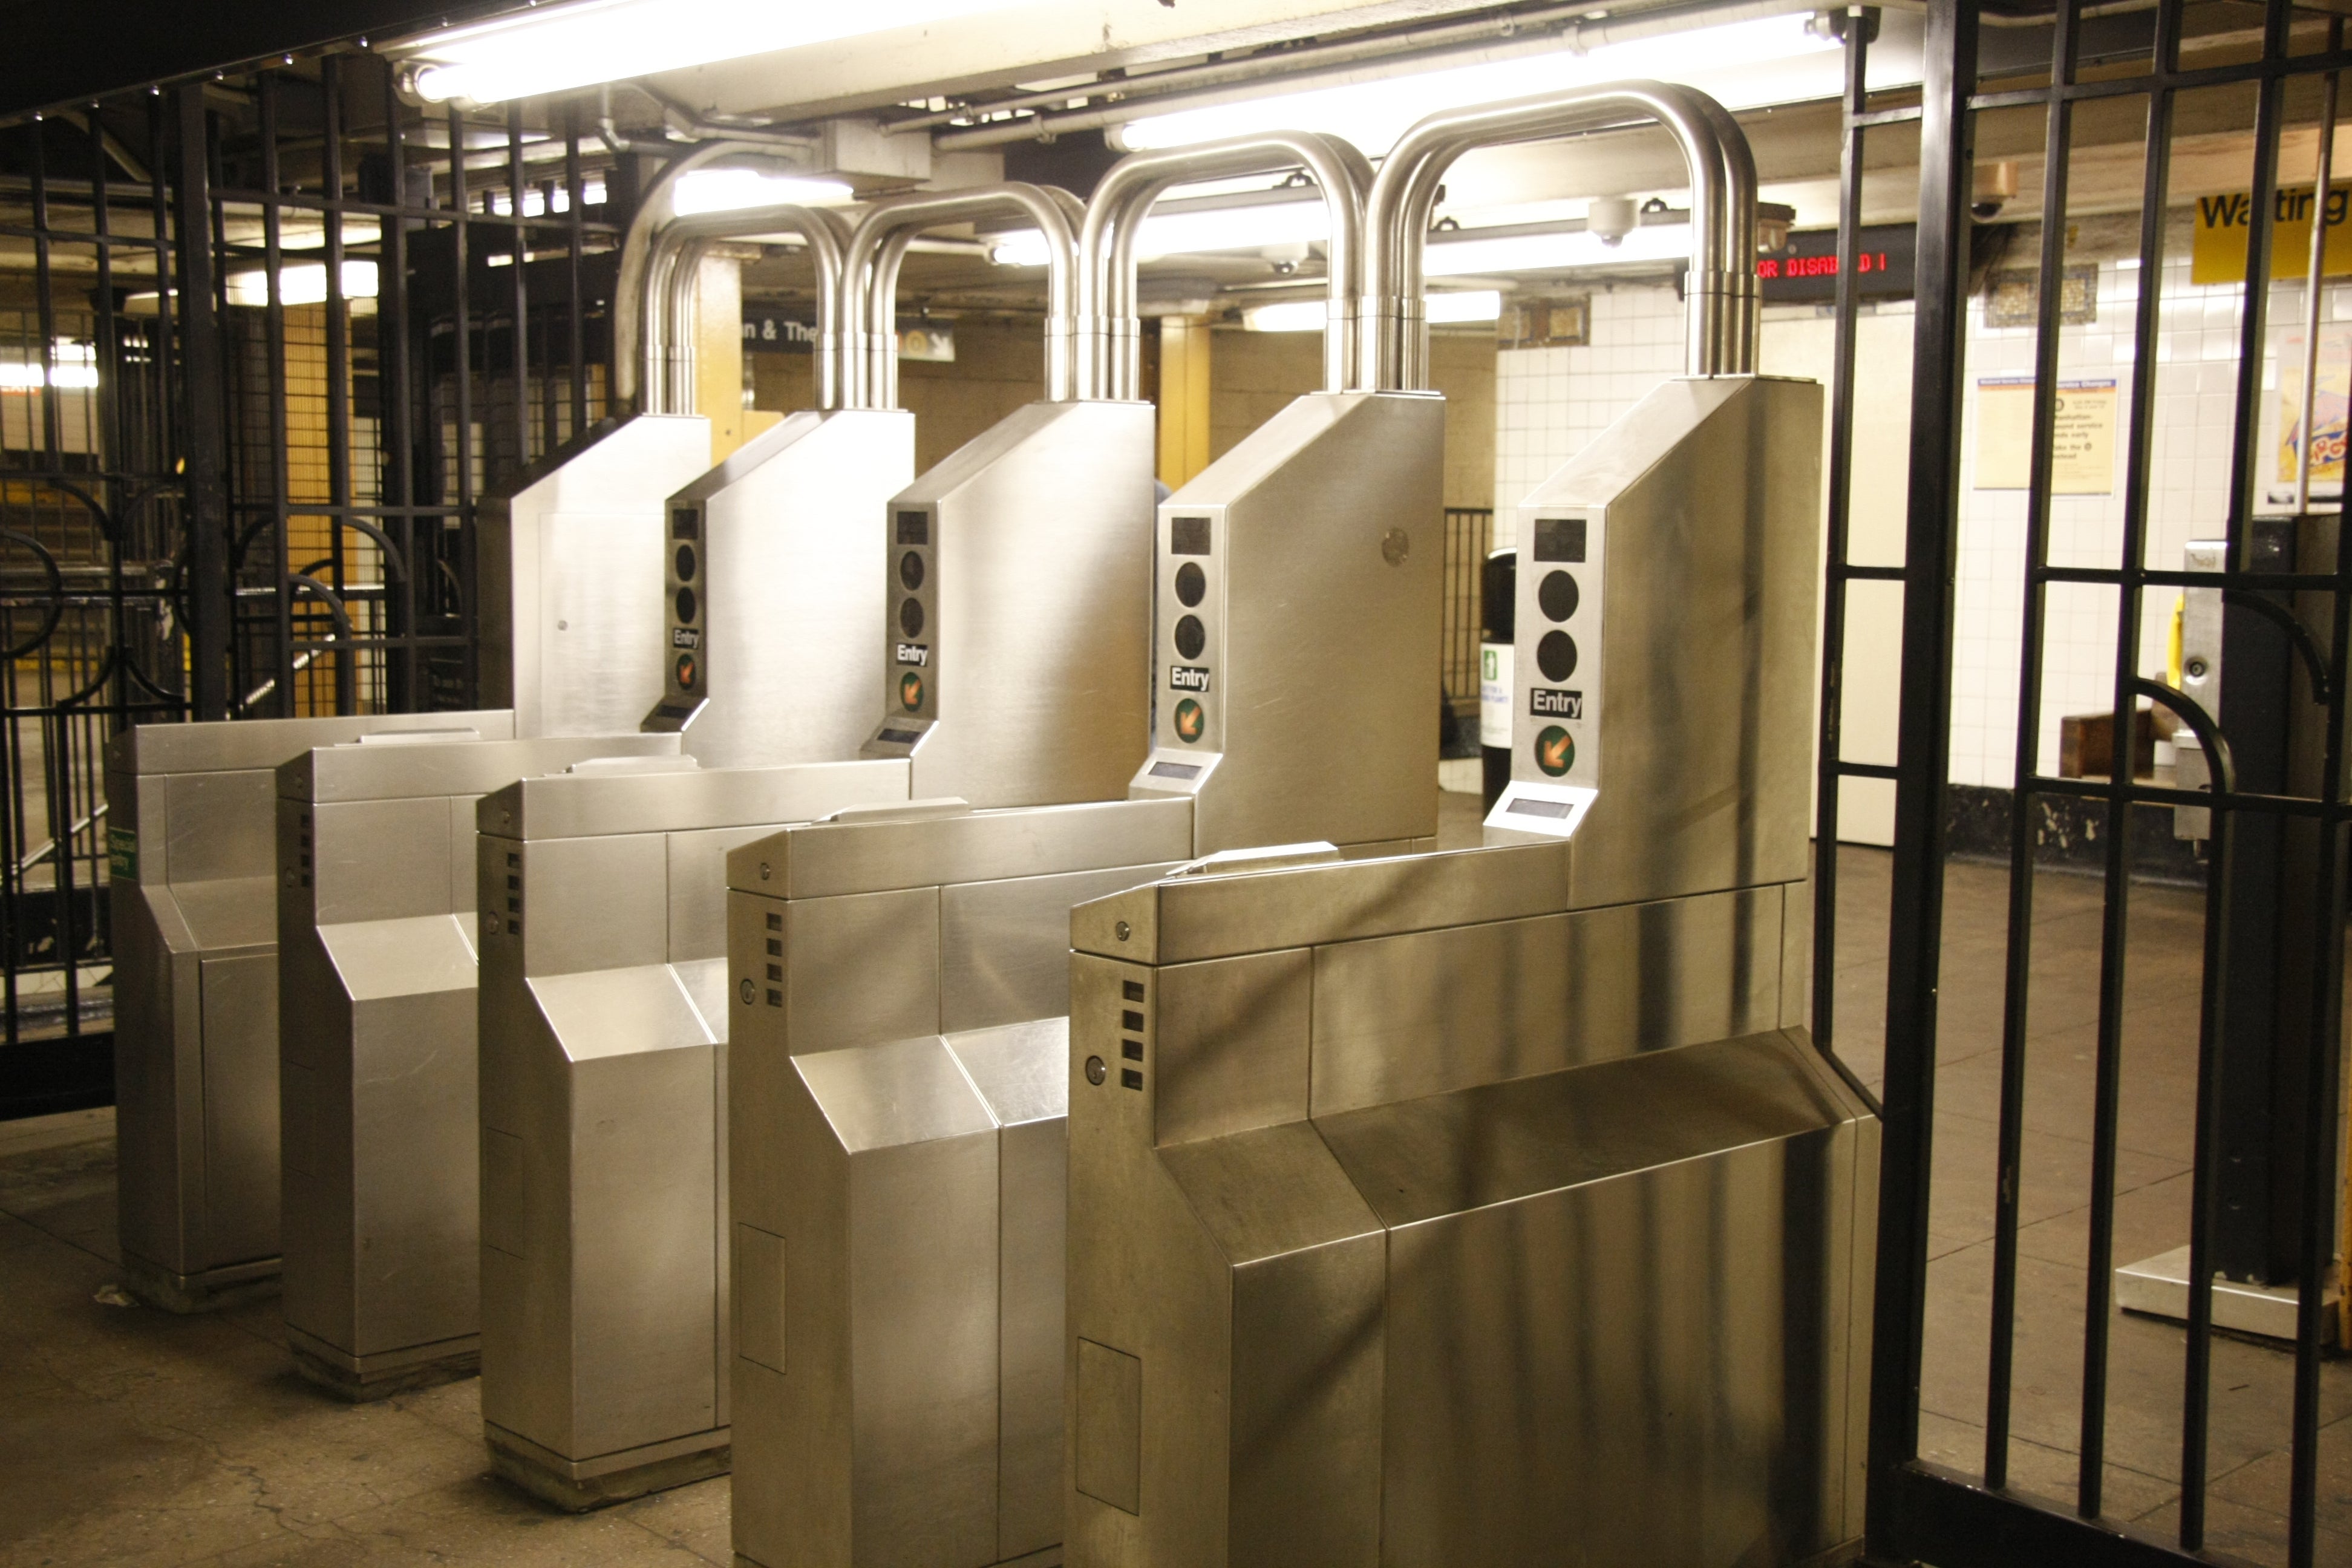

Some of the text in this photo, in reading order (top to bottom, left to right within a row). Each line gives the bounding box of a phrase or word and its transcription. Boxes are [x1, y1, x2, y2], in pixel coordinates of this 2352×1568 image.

[2201, 188, 2349, 229] Wating
[1787, 253, 1871, 276] DISABD
[762, 319, 777, 341] &
[675, 629, 700, 649] Entry
[898, 644, 929, 667] Entry
[1172, 667, 1210, 691] Entry
[1534, 690, 1581, 718] Entry
